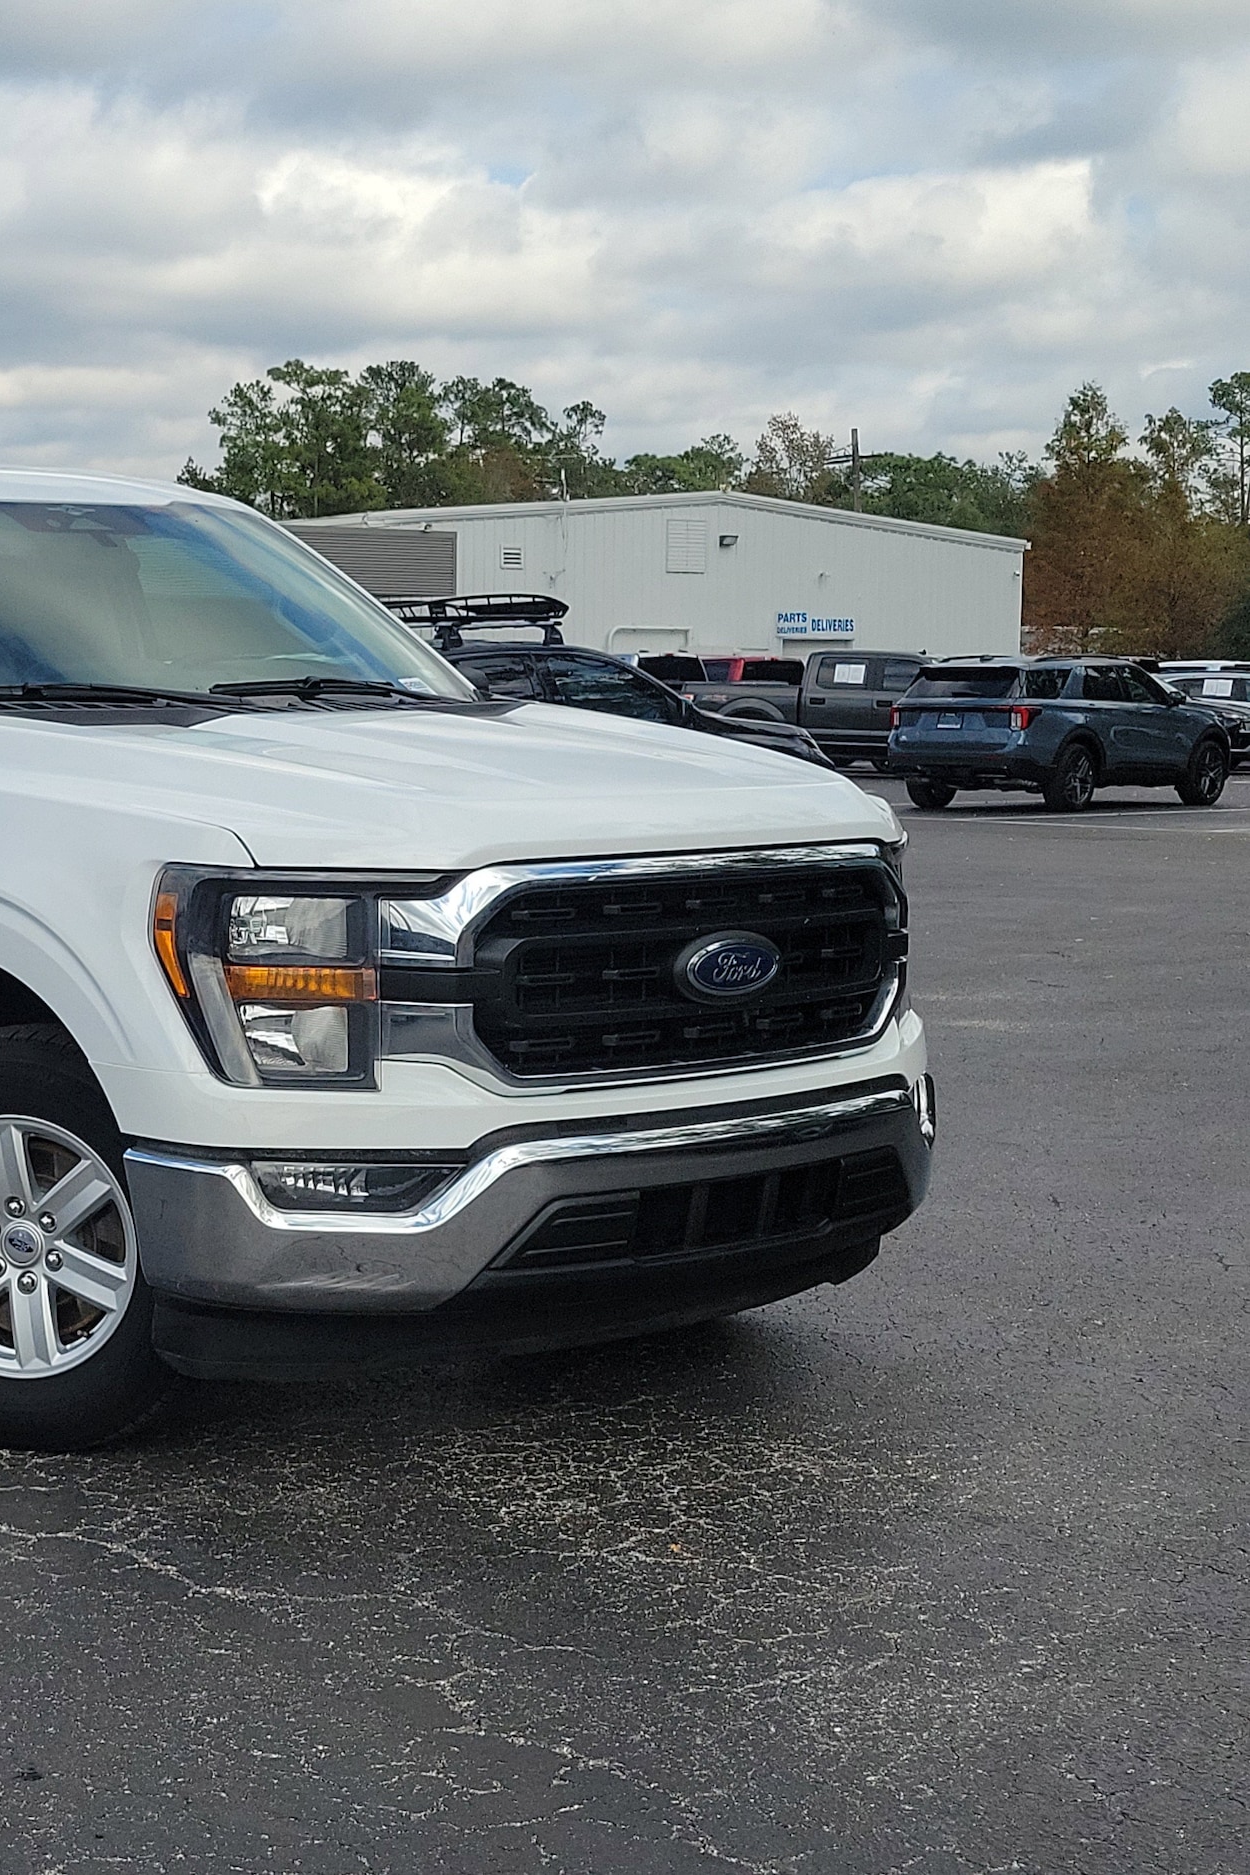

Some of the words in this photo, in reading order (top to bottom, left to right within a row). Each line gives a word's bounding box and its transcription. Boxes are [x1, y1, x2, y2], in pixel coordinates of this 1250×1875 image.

[777, 612, 807, 623] PARTS
[776, 626, 807, 634] DELIVERIES
[811, 618, 854, 632] DELIVERIES
[712, 951, 762, 983] Ford
